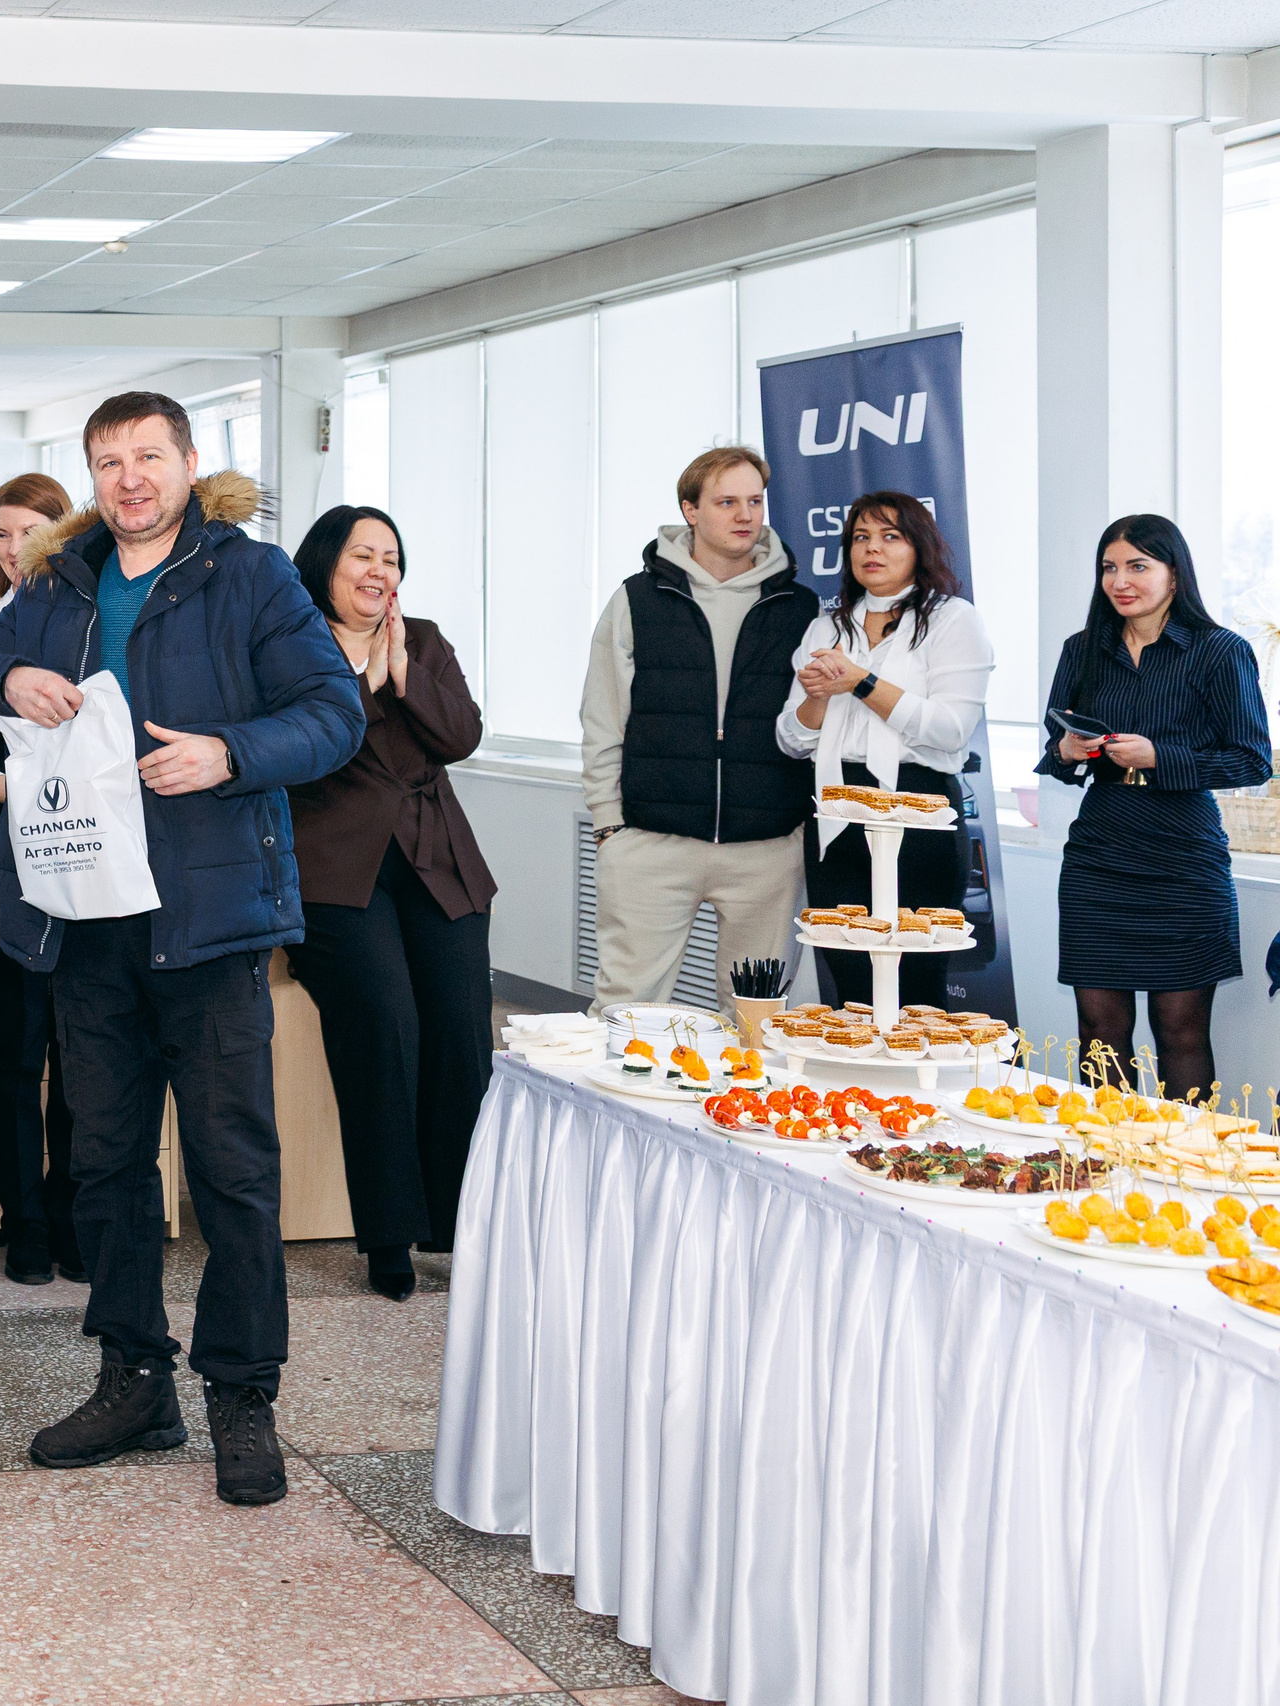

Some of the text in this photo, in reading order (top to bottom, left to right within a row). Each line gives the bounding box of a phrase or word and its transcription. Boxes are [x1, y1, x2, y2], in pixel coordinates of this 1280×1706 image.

[798, 392, 927, 456] UNI
[20, 817, 96, 836] CHANGAN
[25, 842, 102, 859] Агат-Авто
